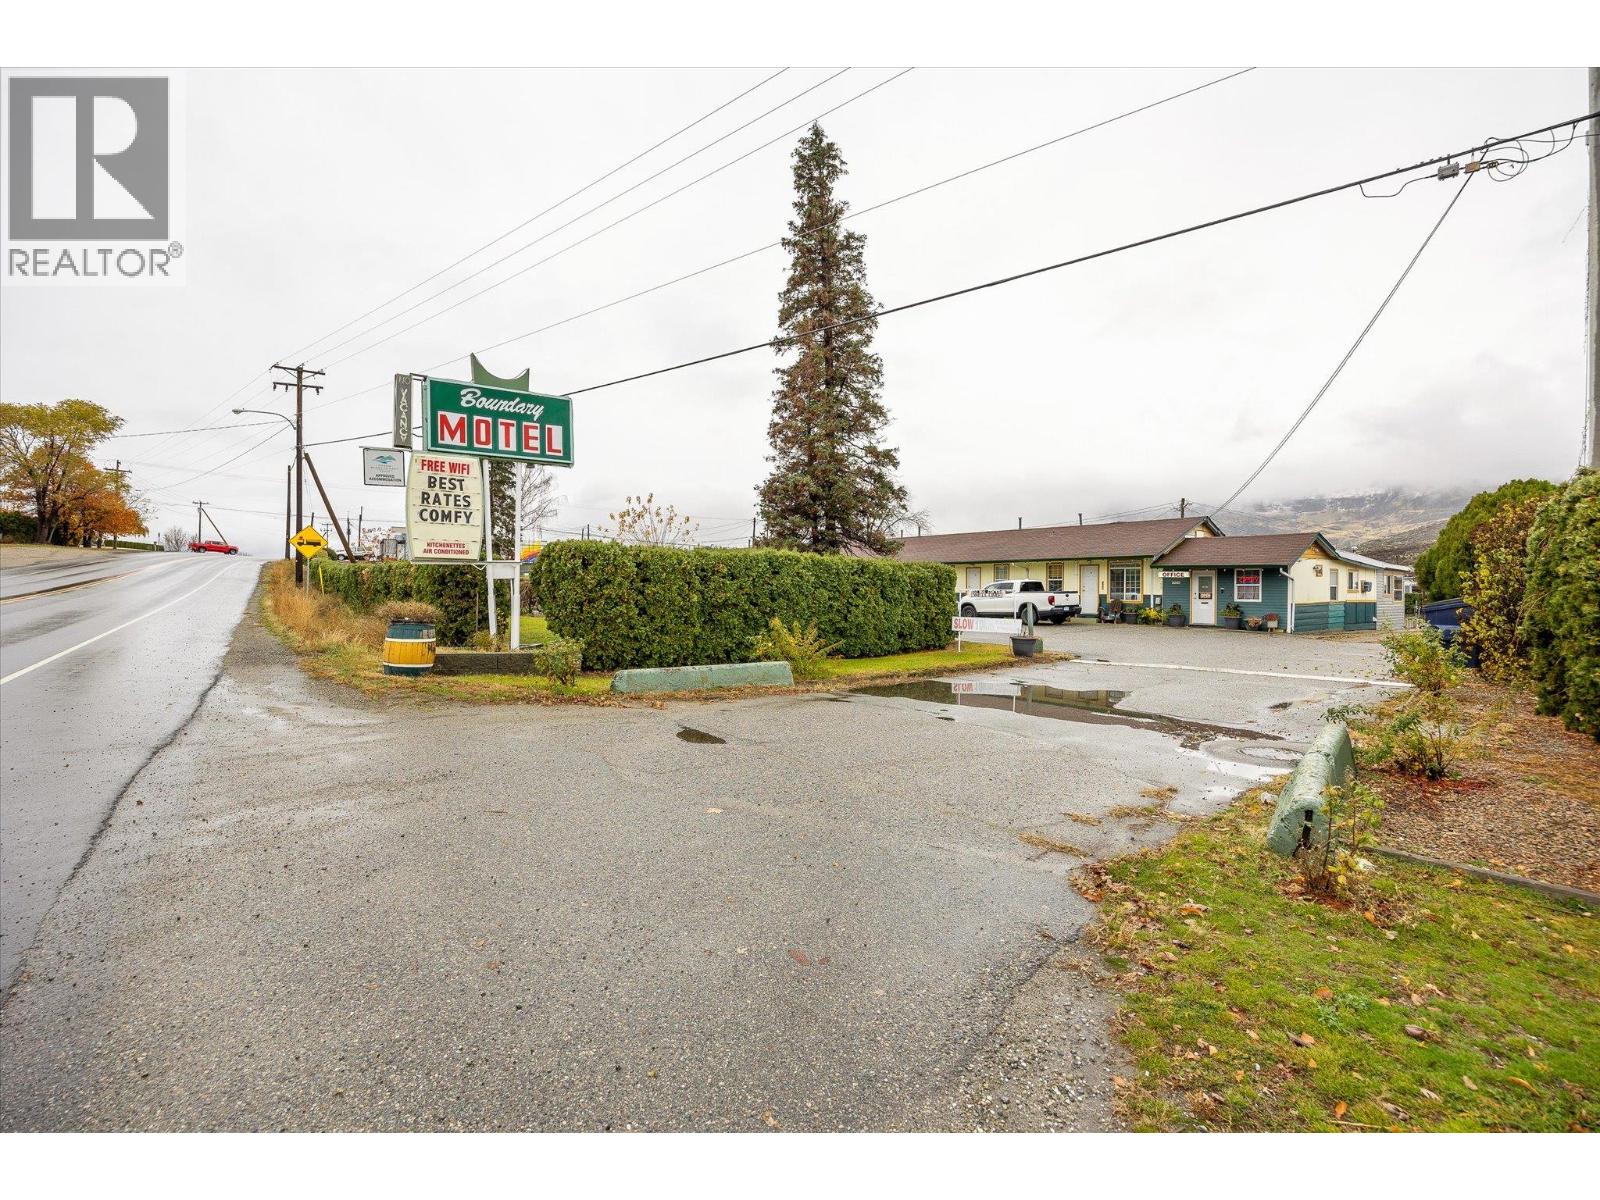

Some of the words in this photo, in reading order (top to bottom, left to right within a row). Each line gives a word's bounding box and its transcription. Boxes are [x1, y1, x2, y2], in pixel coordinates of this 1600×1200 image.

[460, 388, 545, 421] Boundary
[399, 388, 409, 442] VACANCY
[439, 413, 563, 455] MOTEL
[420, 458, 446, 474] FREE
[448, 461, 470, 476] WIFI
[427, 475, 465, 492] BEST
[420, 492, 471, 508] RATES
[418, 508, 473, 525] COMFY
[953, 618, 974, 630] SLOW
